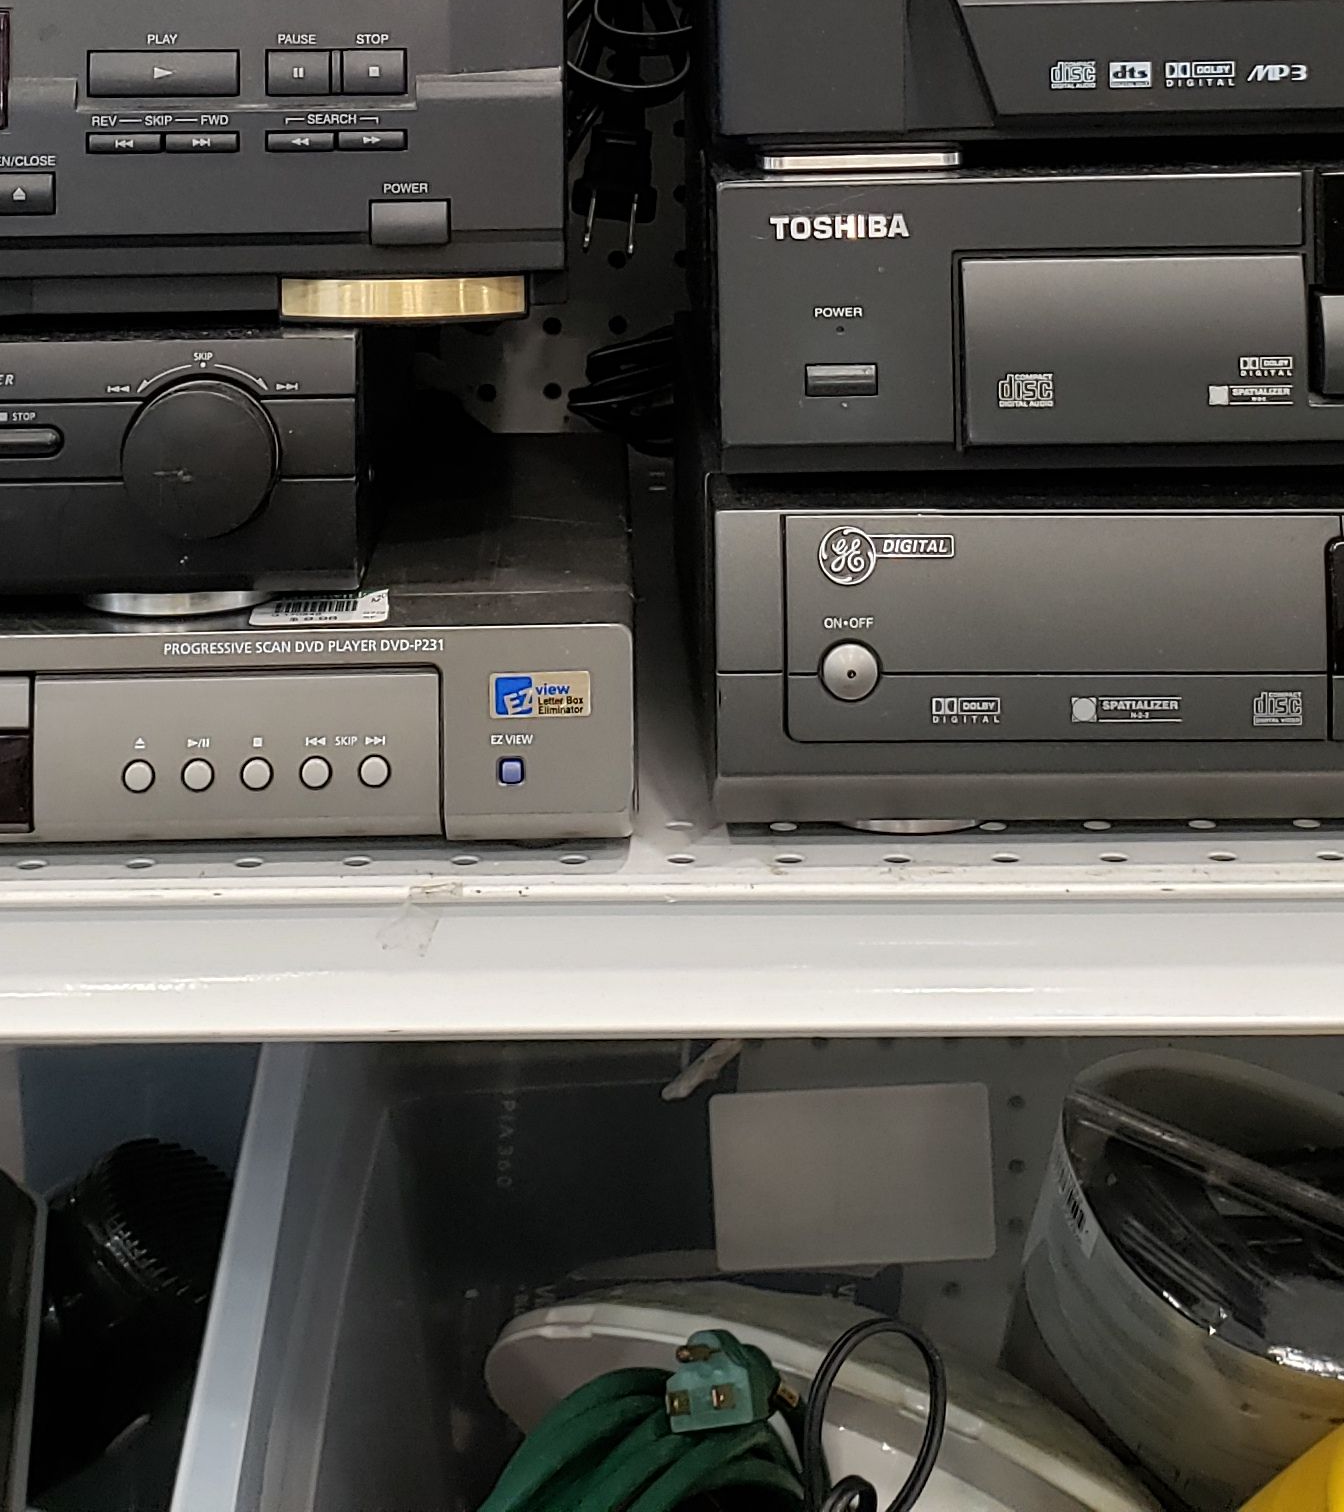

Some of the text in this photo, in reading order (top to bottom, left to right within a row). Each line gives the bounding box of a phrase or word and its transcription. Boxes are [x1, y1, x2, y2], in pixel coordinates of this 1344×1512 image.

[147, 34, 177, 45] PLAY
[278, 34, 316, 45] PAUSE
[356, 34, 389, 45] STOP
[1247, 64, 1308, 82] MP3
[1166, 79, 1235, 87] DIGITAL
[92, 115, 229, 127] REV SKIP FWD
[307, 114, 356, 125] SEARCH
[383, 183, 428, 194] POWER
[770, 213, 910, 239] TOSHIBA
[814, 307, 863, 317] POWER
[193, 350, 213, 361] SKIP
[12, 411, 36, 422] STOP
[882, 539, 947, 553] DIGITAL
[164, 638, 444, 656] PROGRESSIVE SCAN DVD PLAYER DVD-P231
[536, 683, 569, 695] view
[538, 695, 584, 706] Letter Box
[1102, 700, 1179, 711] SPATIALIZER
[538, 704, 584, 715] Eliminator
[335, 736, 357, 746] SKIP
[490, 734, 533, 745] EZ VIEW
